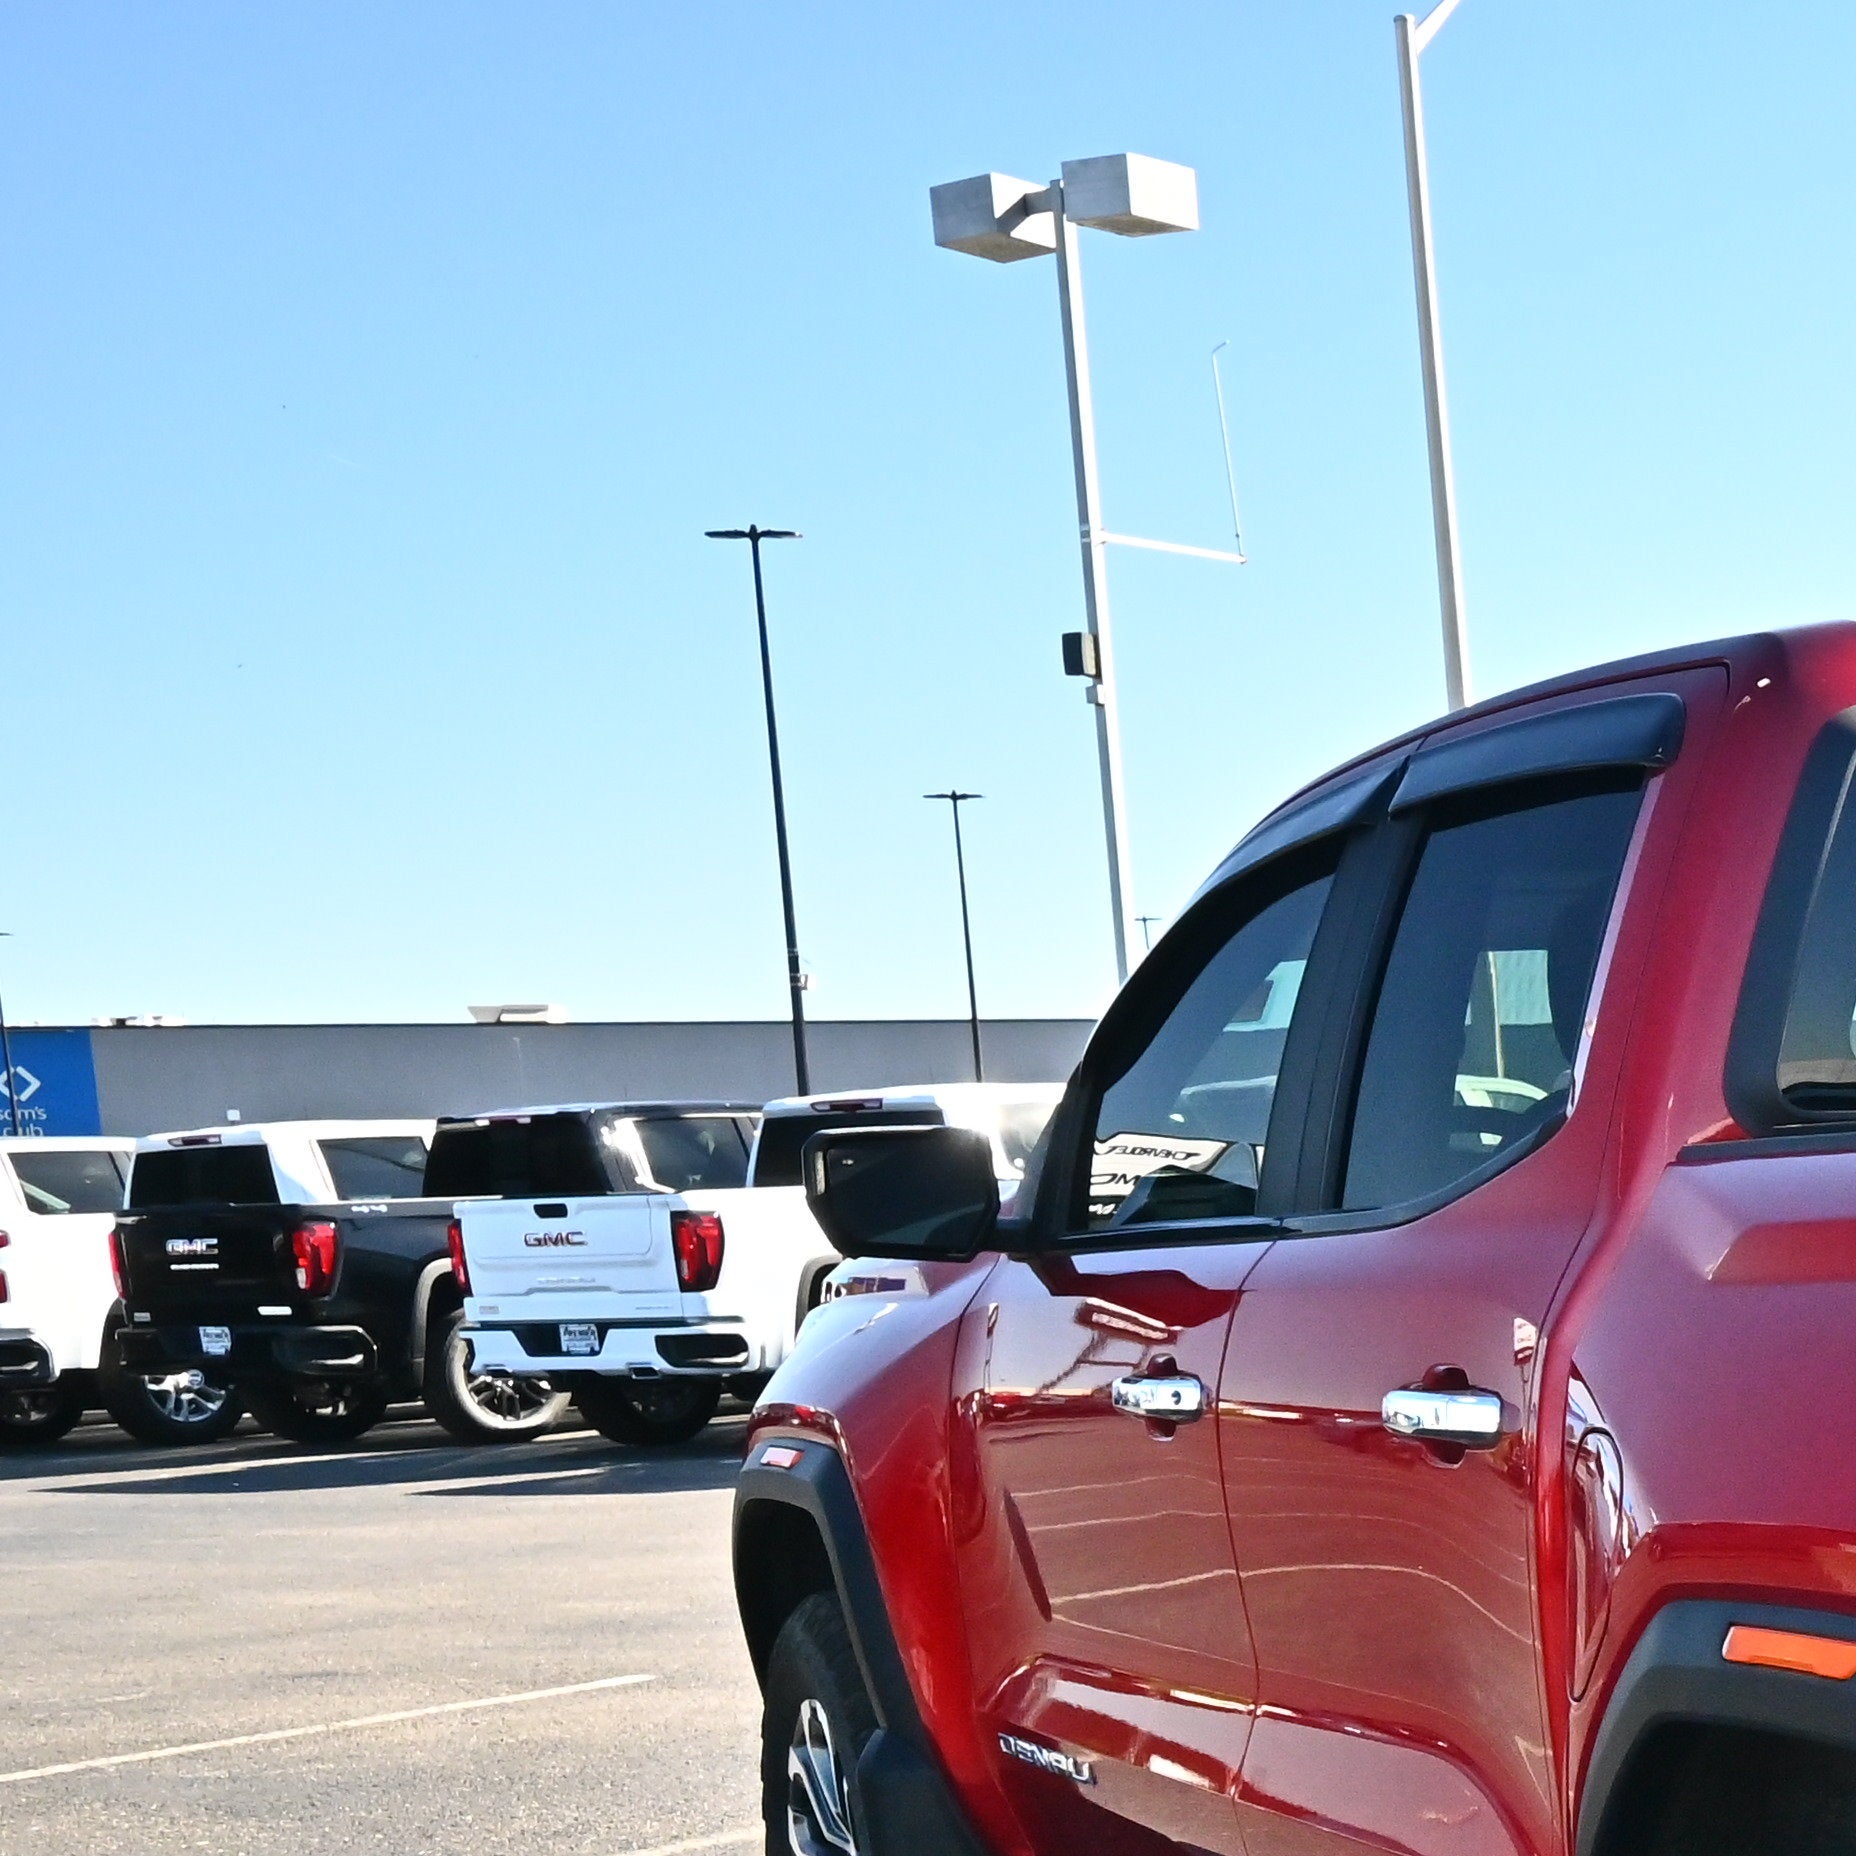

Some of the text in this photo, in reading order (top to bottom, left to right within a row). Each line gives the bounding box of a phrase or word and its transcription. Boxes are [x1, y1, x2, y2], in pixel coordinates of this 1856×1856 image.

[3, 1123, 44, 1136] cub
[166, 1238, 219, 1255] GMC
[524, 1231, 586, 1247] GMC
